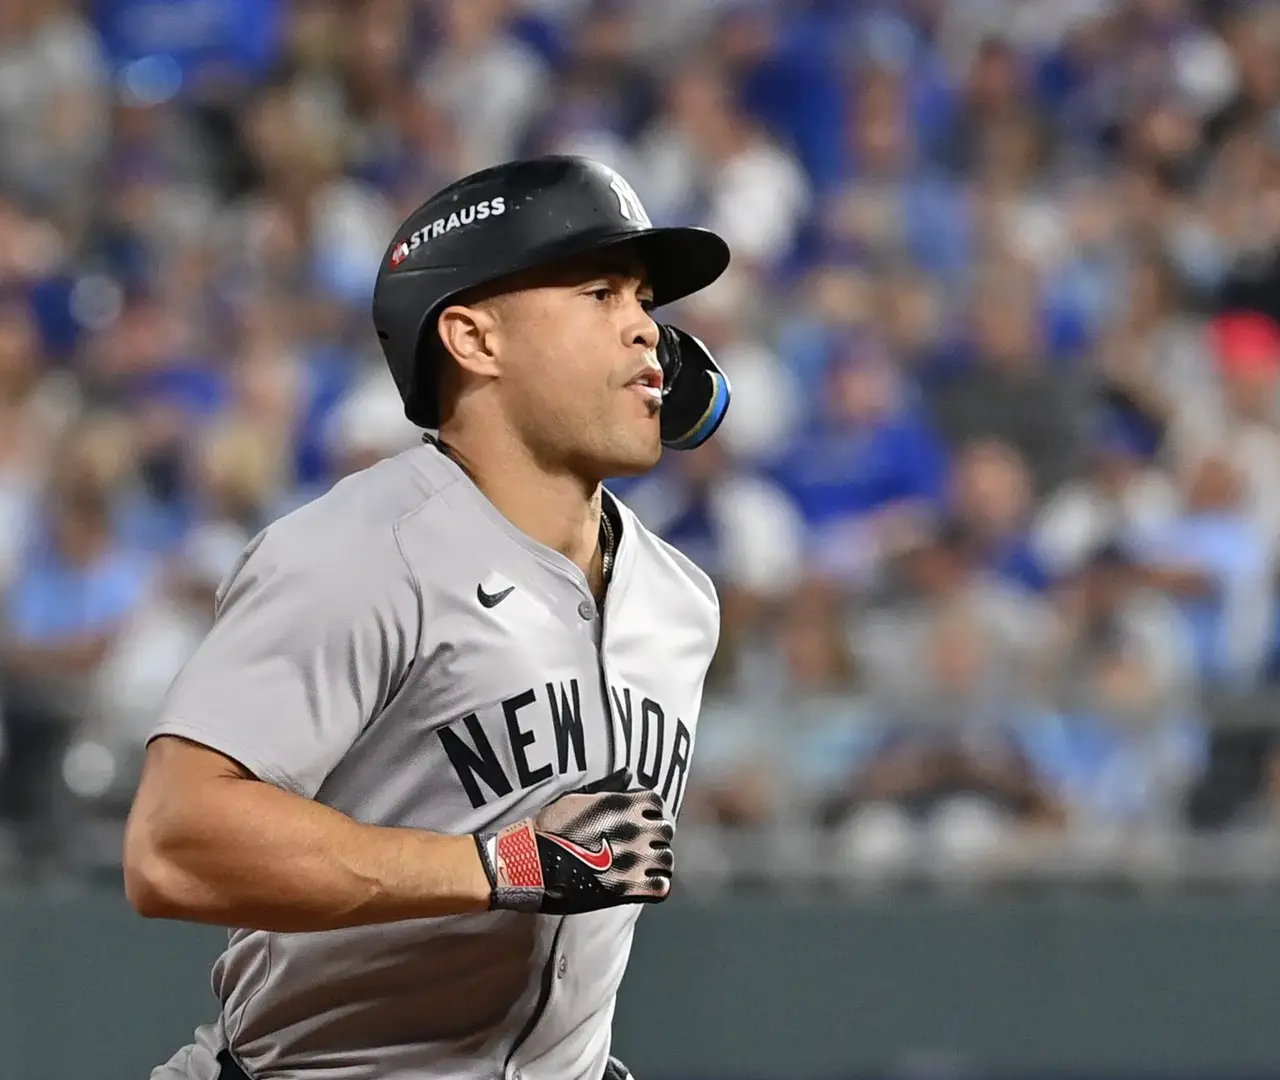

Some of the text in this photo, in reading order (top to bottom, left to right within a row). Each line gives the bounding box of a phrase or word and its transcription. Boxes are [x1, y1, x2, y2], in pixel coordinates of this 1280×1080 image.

[409, 196, 506, 250] STRAUSS
[436, 678, 691, 822] NEW YOR
